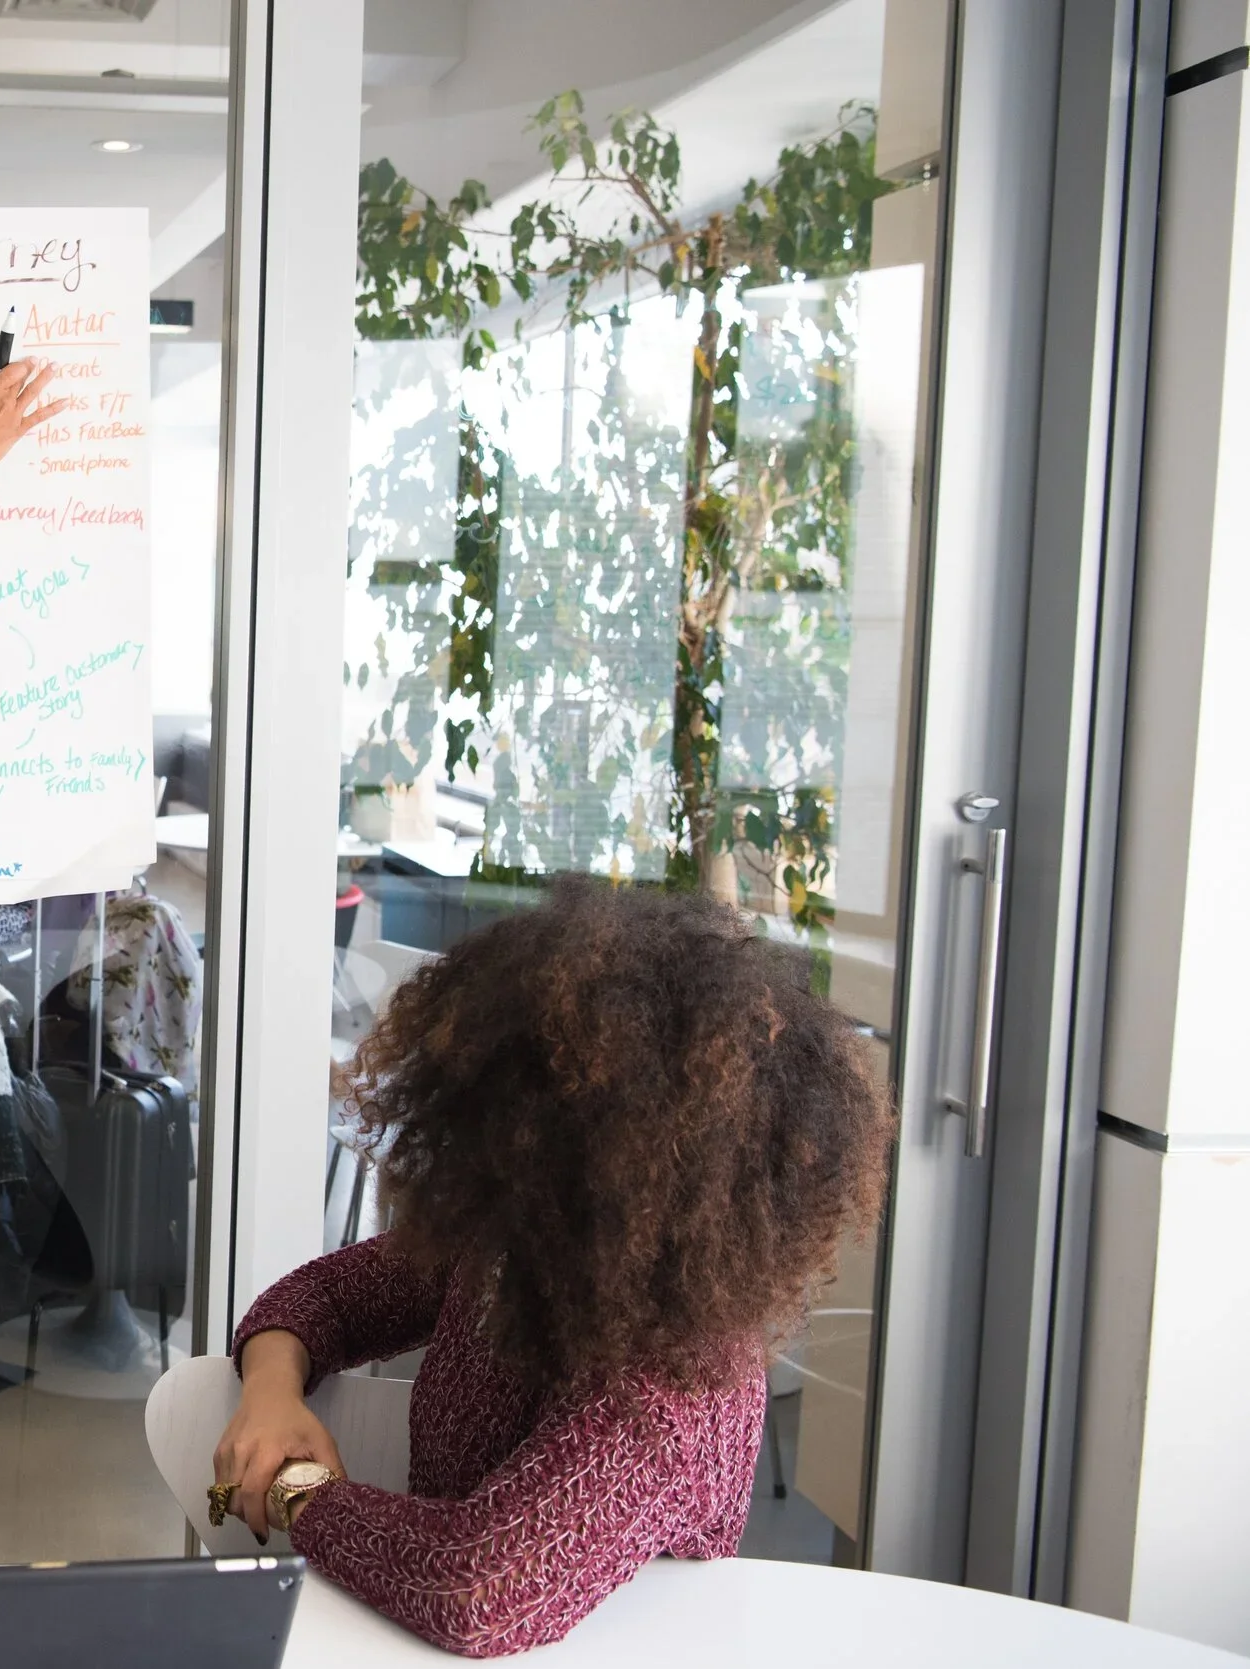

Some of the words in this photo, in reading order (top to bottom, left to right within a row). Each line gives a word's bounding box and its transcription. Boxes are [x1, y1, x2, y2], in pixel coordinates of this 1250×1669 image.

[23, 303, 115, 341] Avatar
[38, 423, 71, 447] Has
[64, 745, 83, 770] to
[45, 771, 106, 797] Friends
